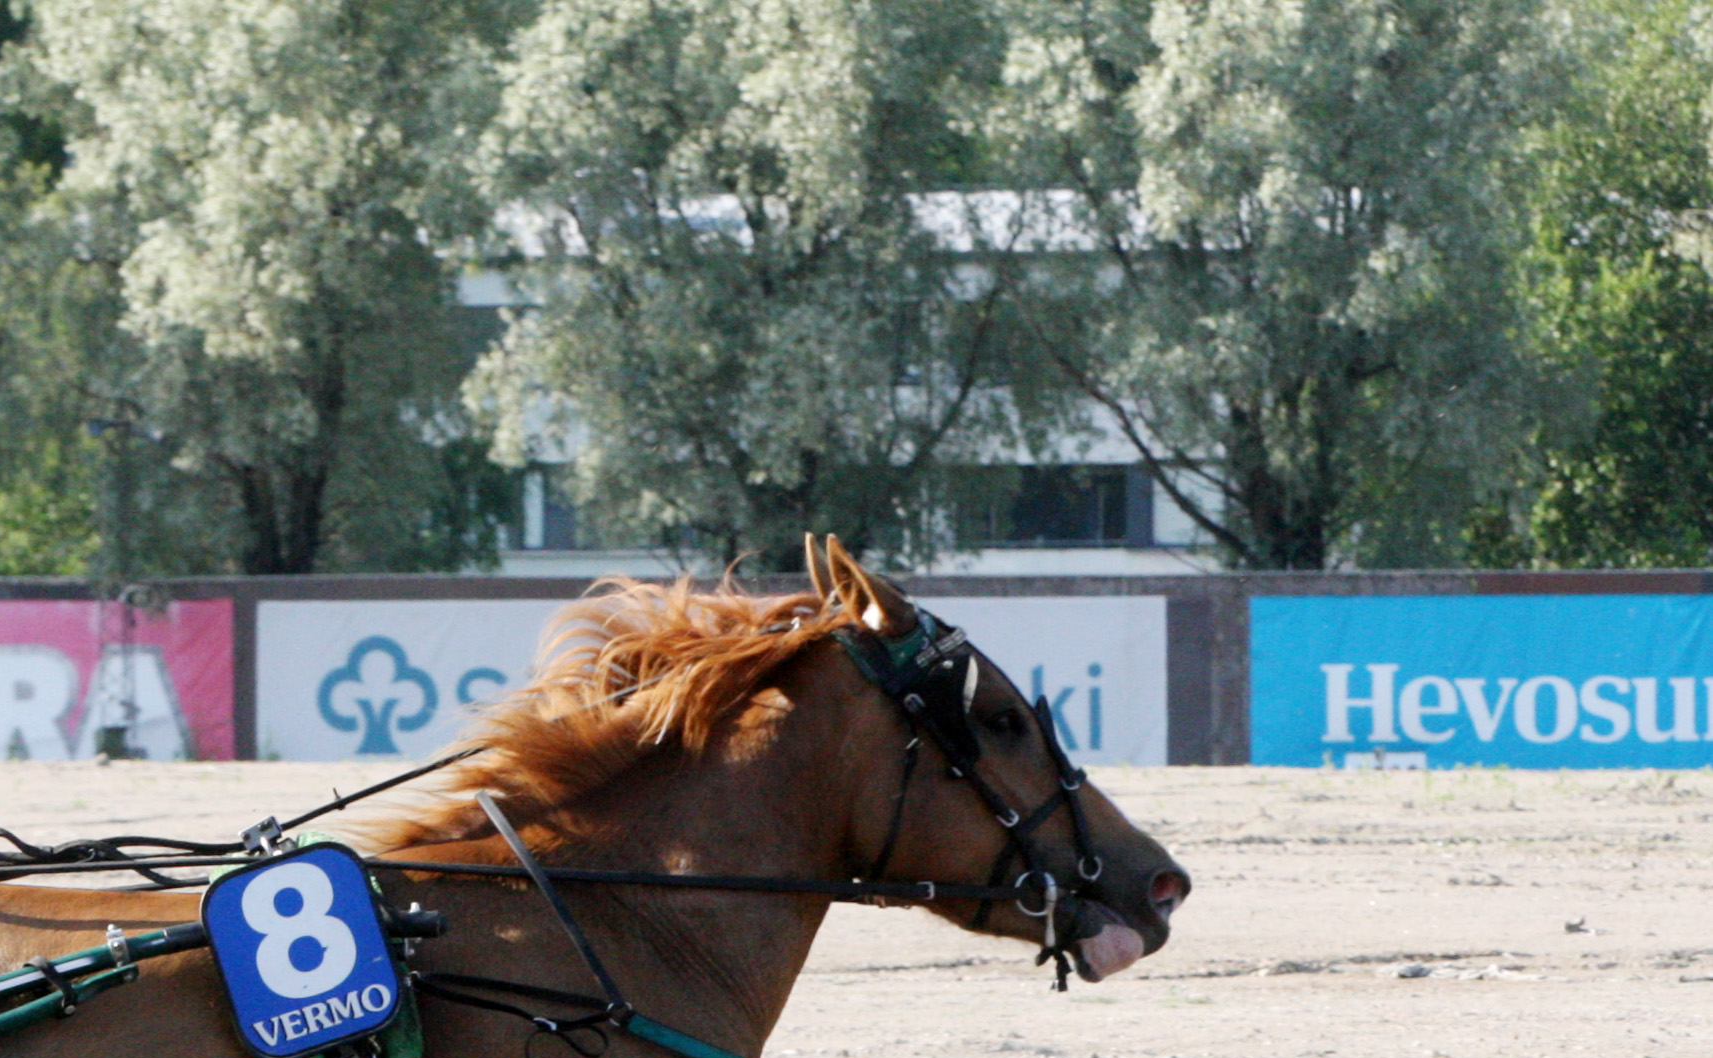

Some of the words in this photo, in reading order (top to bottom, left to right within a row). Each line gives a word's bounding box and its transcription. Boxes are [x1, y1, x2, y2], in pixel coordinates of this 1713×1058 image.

[1320, 663, 1713, 744] Hevosu
[241, 861, 357, 999] 8
[252, 983, 392, 1047] VERMO
